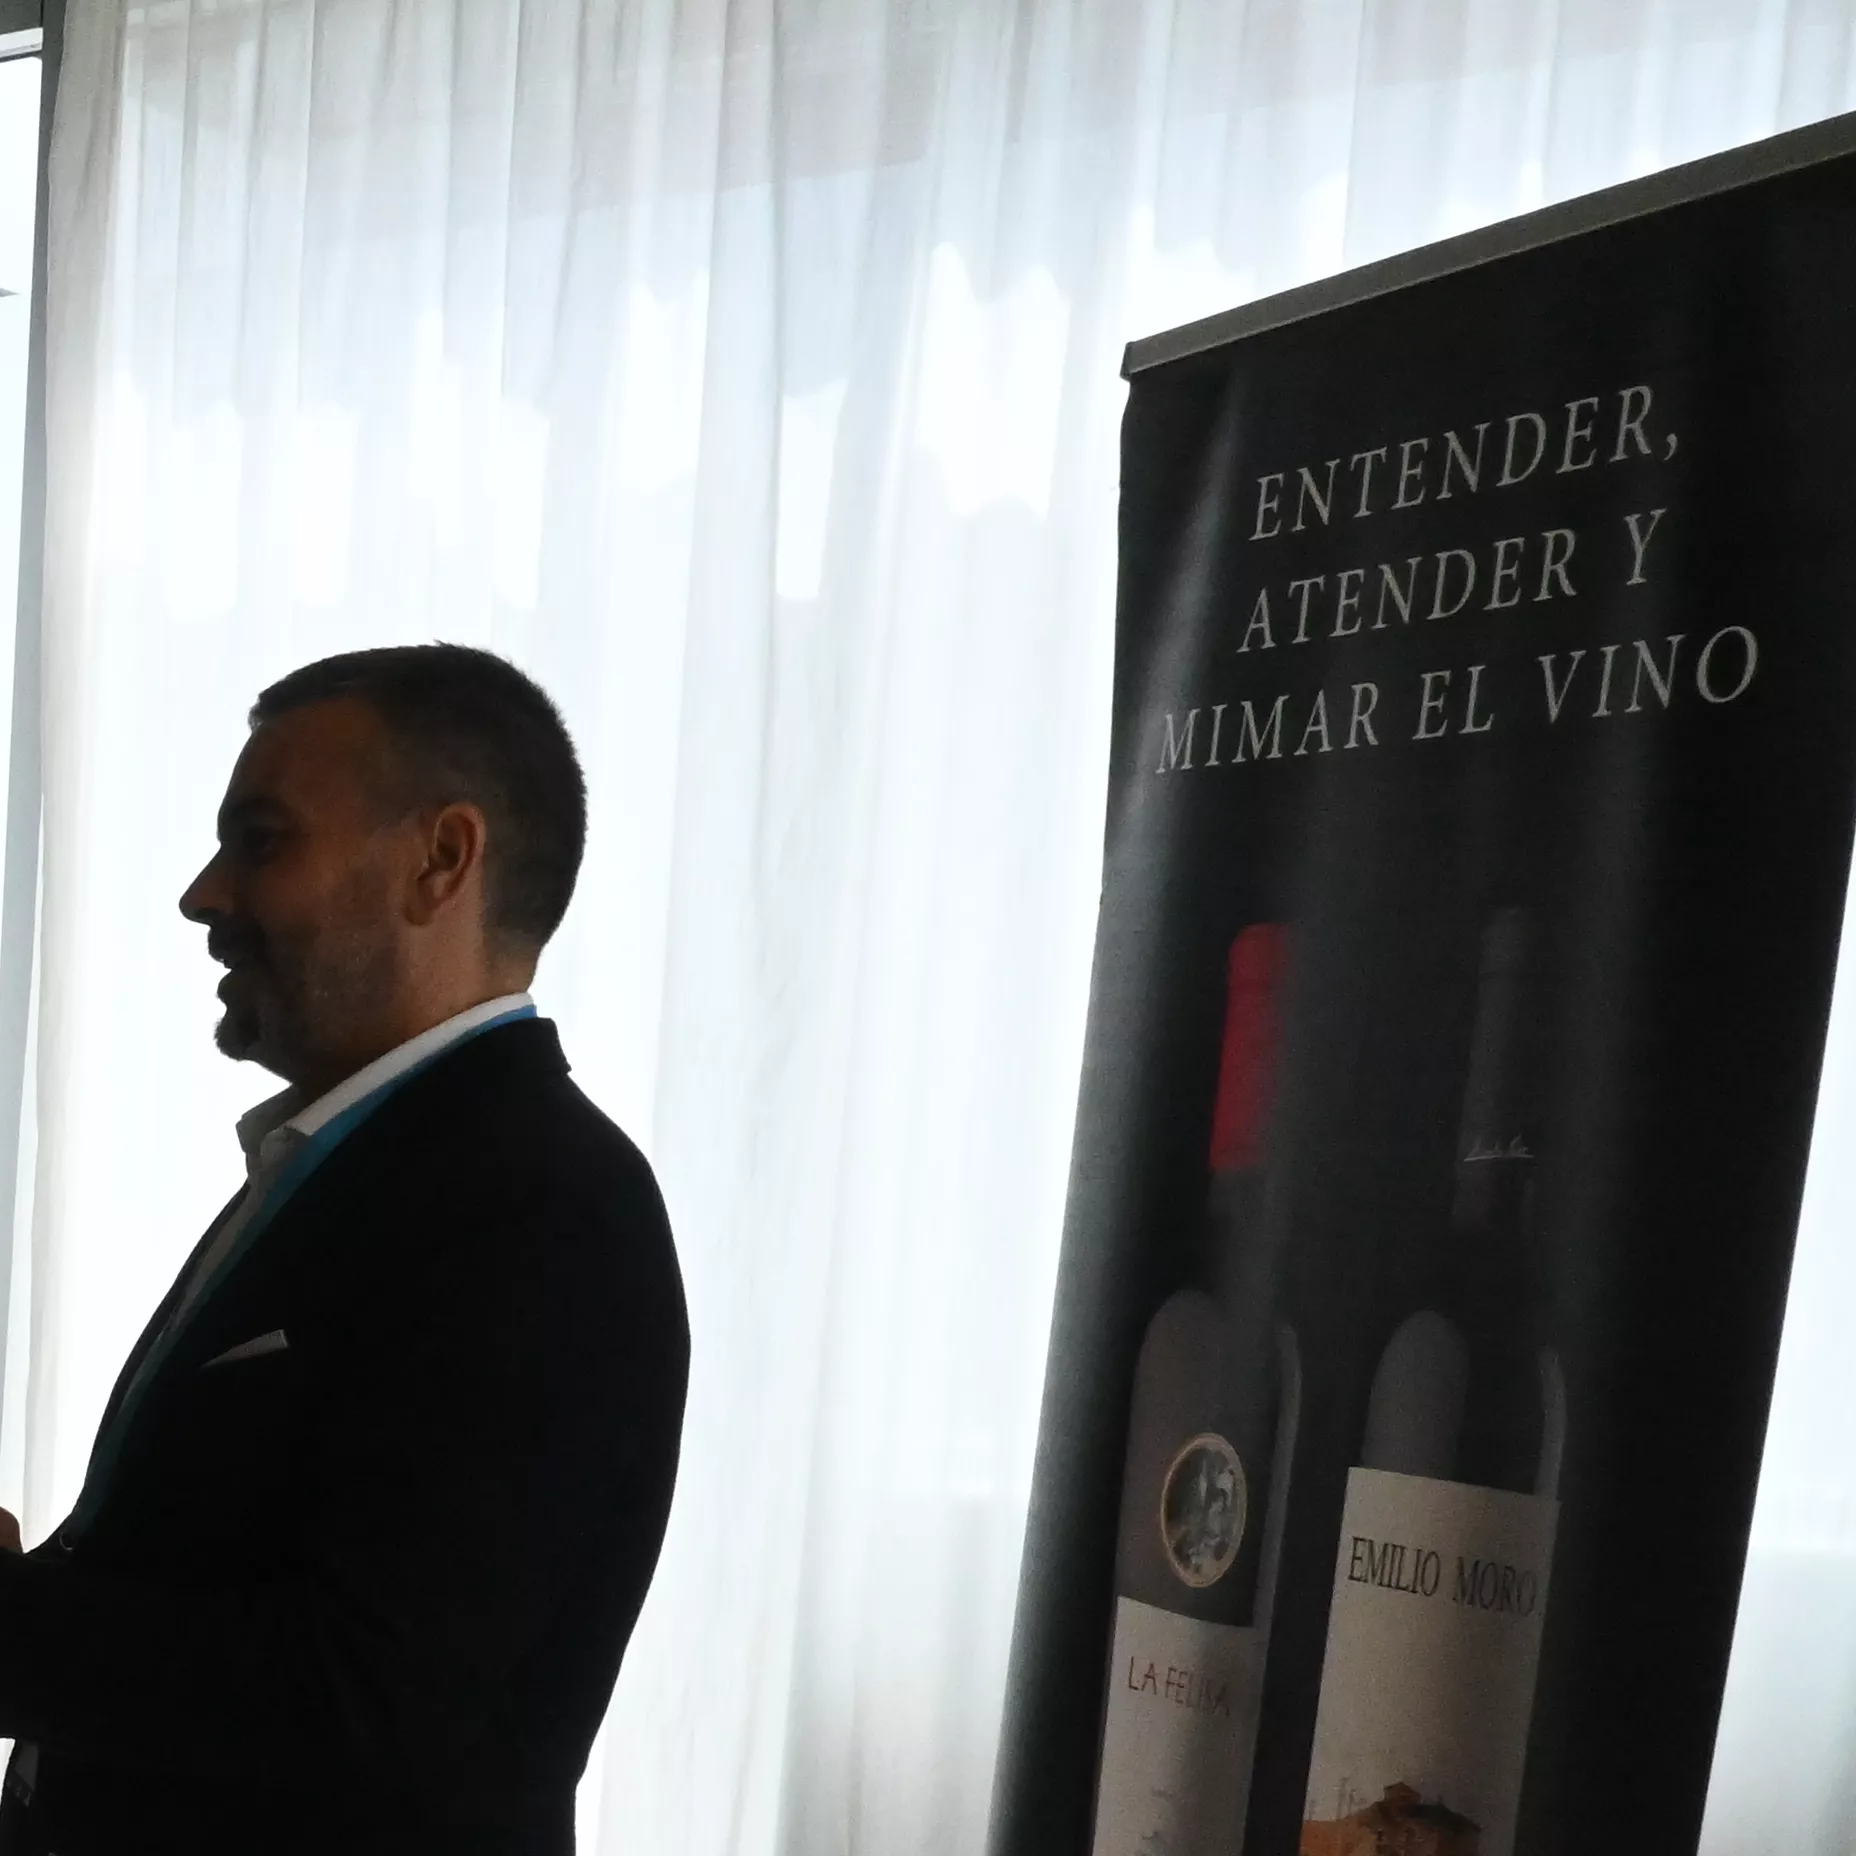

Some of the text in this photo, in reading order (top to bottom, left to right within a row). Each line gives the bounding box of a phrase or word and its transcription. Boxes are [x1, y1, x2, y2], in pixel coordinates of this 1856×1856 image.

[1249, 384, 1678, 541] ENTENDER,
[1237, 507, 1667, 653] ATENDER Y
[1156, 625, 1758, 774] MIMAR EL VINO
[1347, 1535, 1539, 1618] EMILIO MORO
